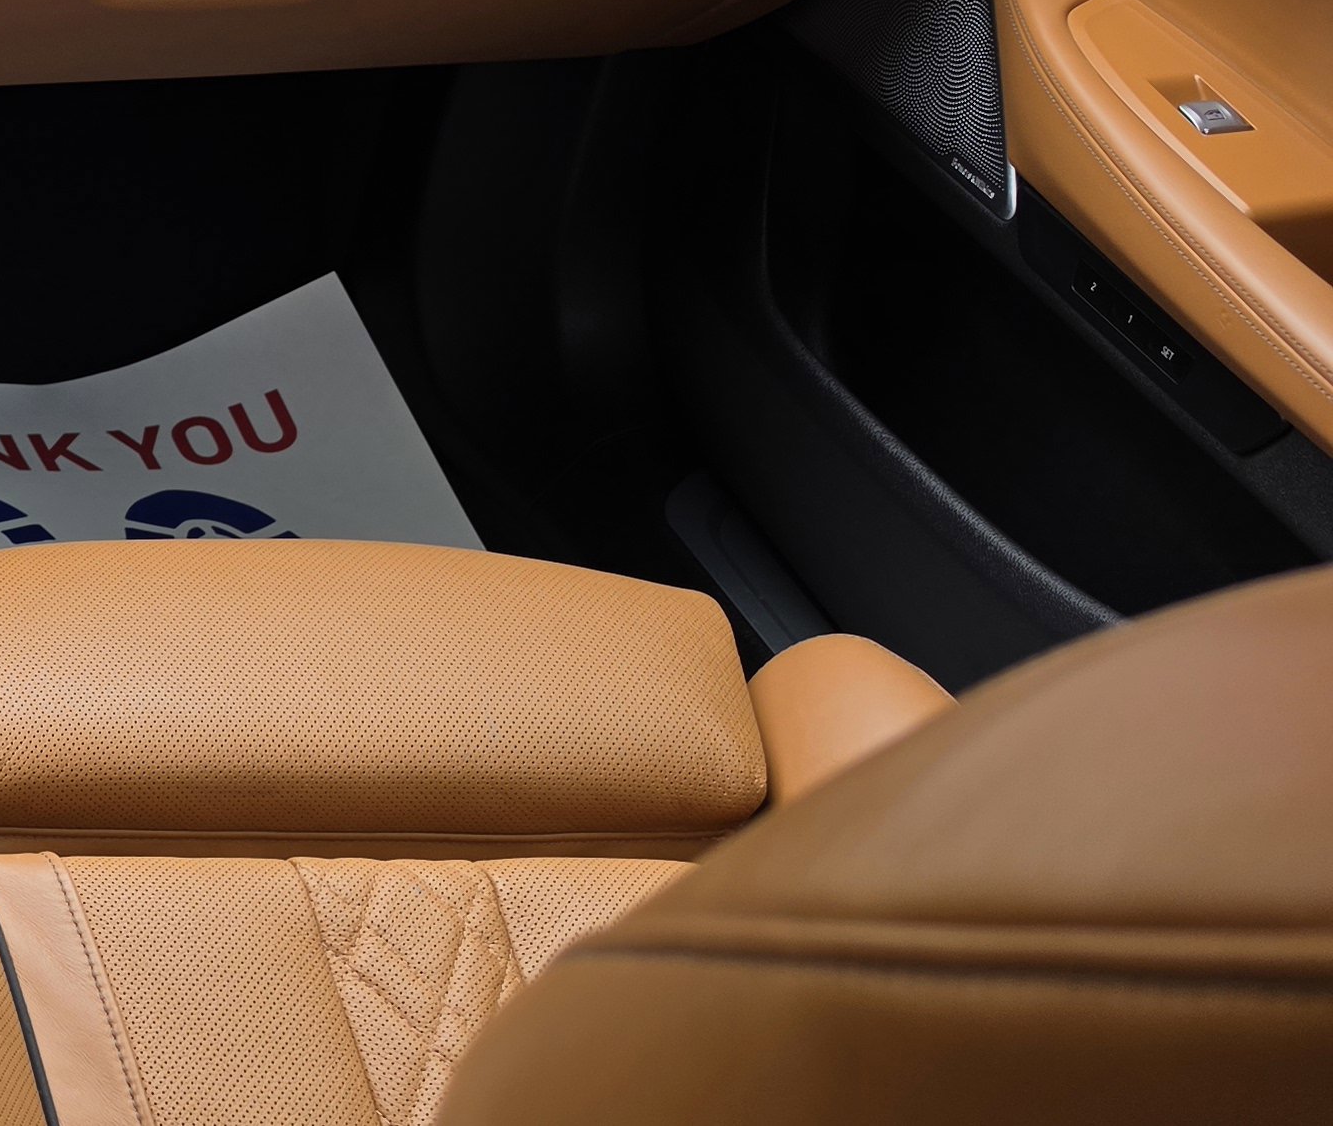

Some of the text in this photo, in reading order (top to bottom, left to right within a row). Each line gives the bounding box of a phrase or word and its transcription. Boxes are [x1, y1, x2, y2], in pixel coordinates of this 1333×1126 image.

[1090, 282, 1097, 291] 2
[1160, 345, 1175, 361] SET
[106, 388, 299, 471] YOU
